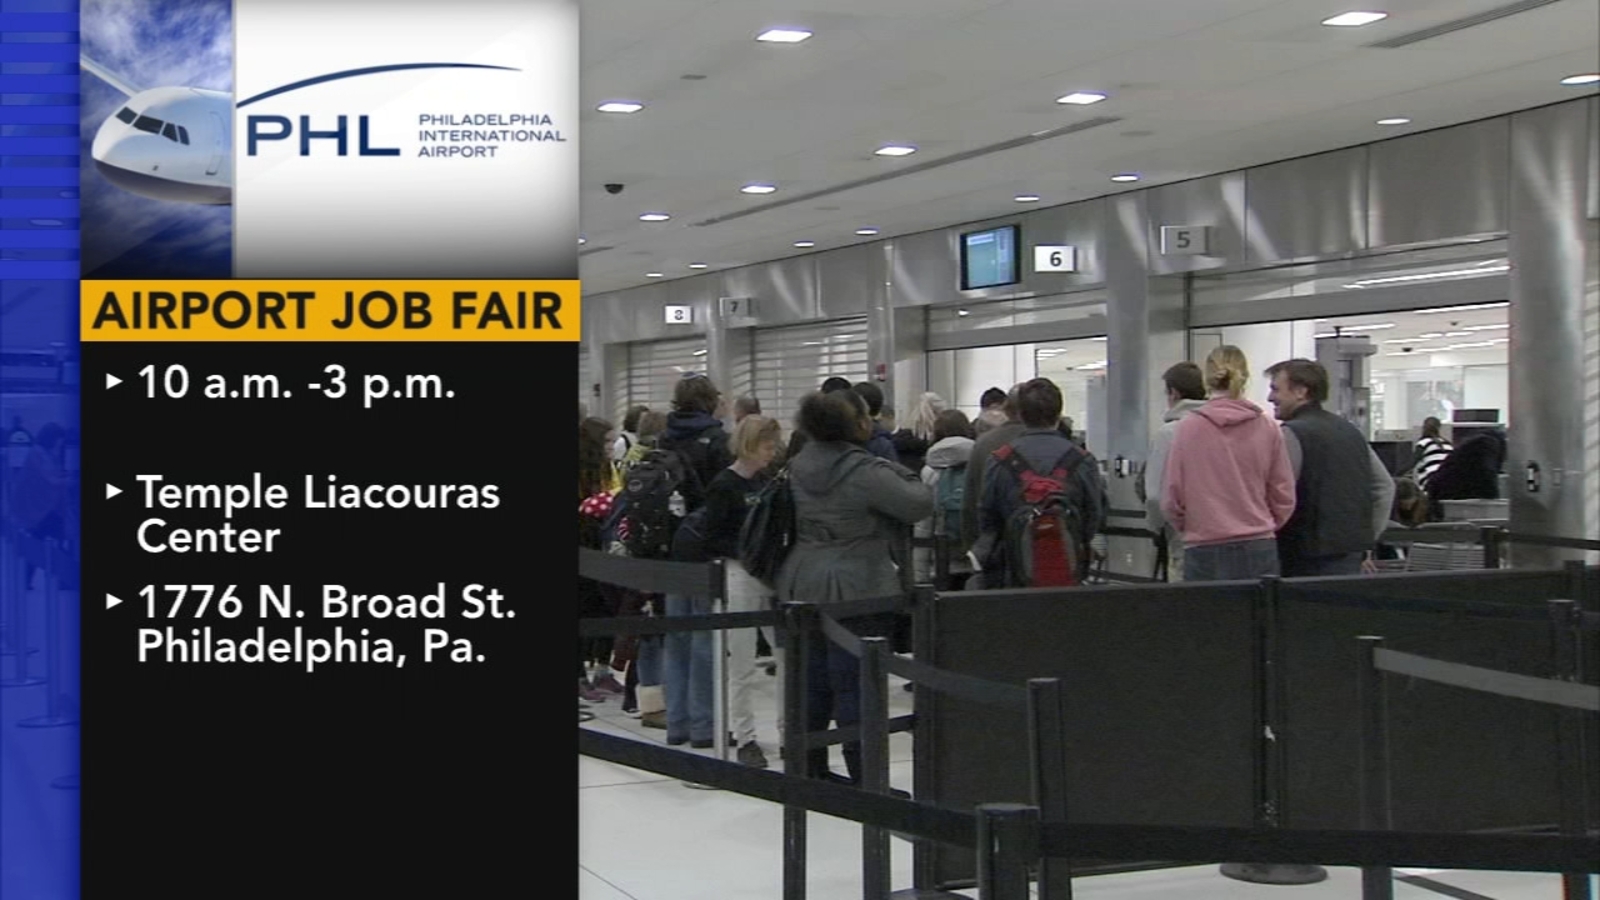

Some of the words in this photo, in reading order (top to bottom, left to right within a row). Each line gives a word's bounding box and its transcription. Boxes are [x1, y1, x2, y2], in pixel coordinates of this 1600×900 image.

[1177, 231, 1190, 248] 5
[1050, 251, 1062, 267] 6
[730, 301, 738, 313] 7
